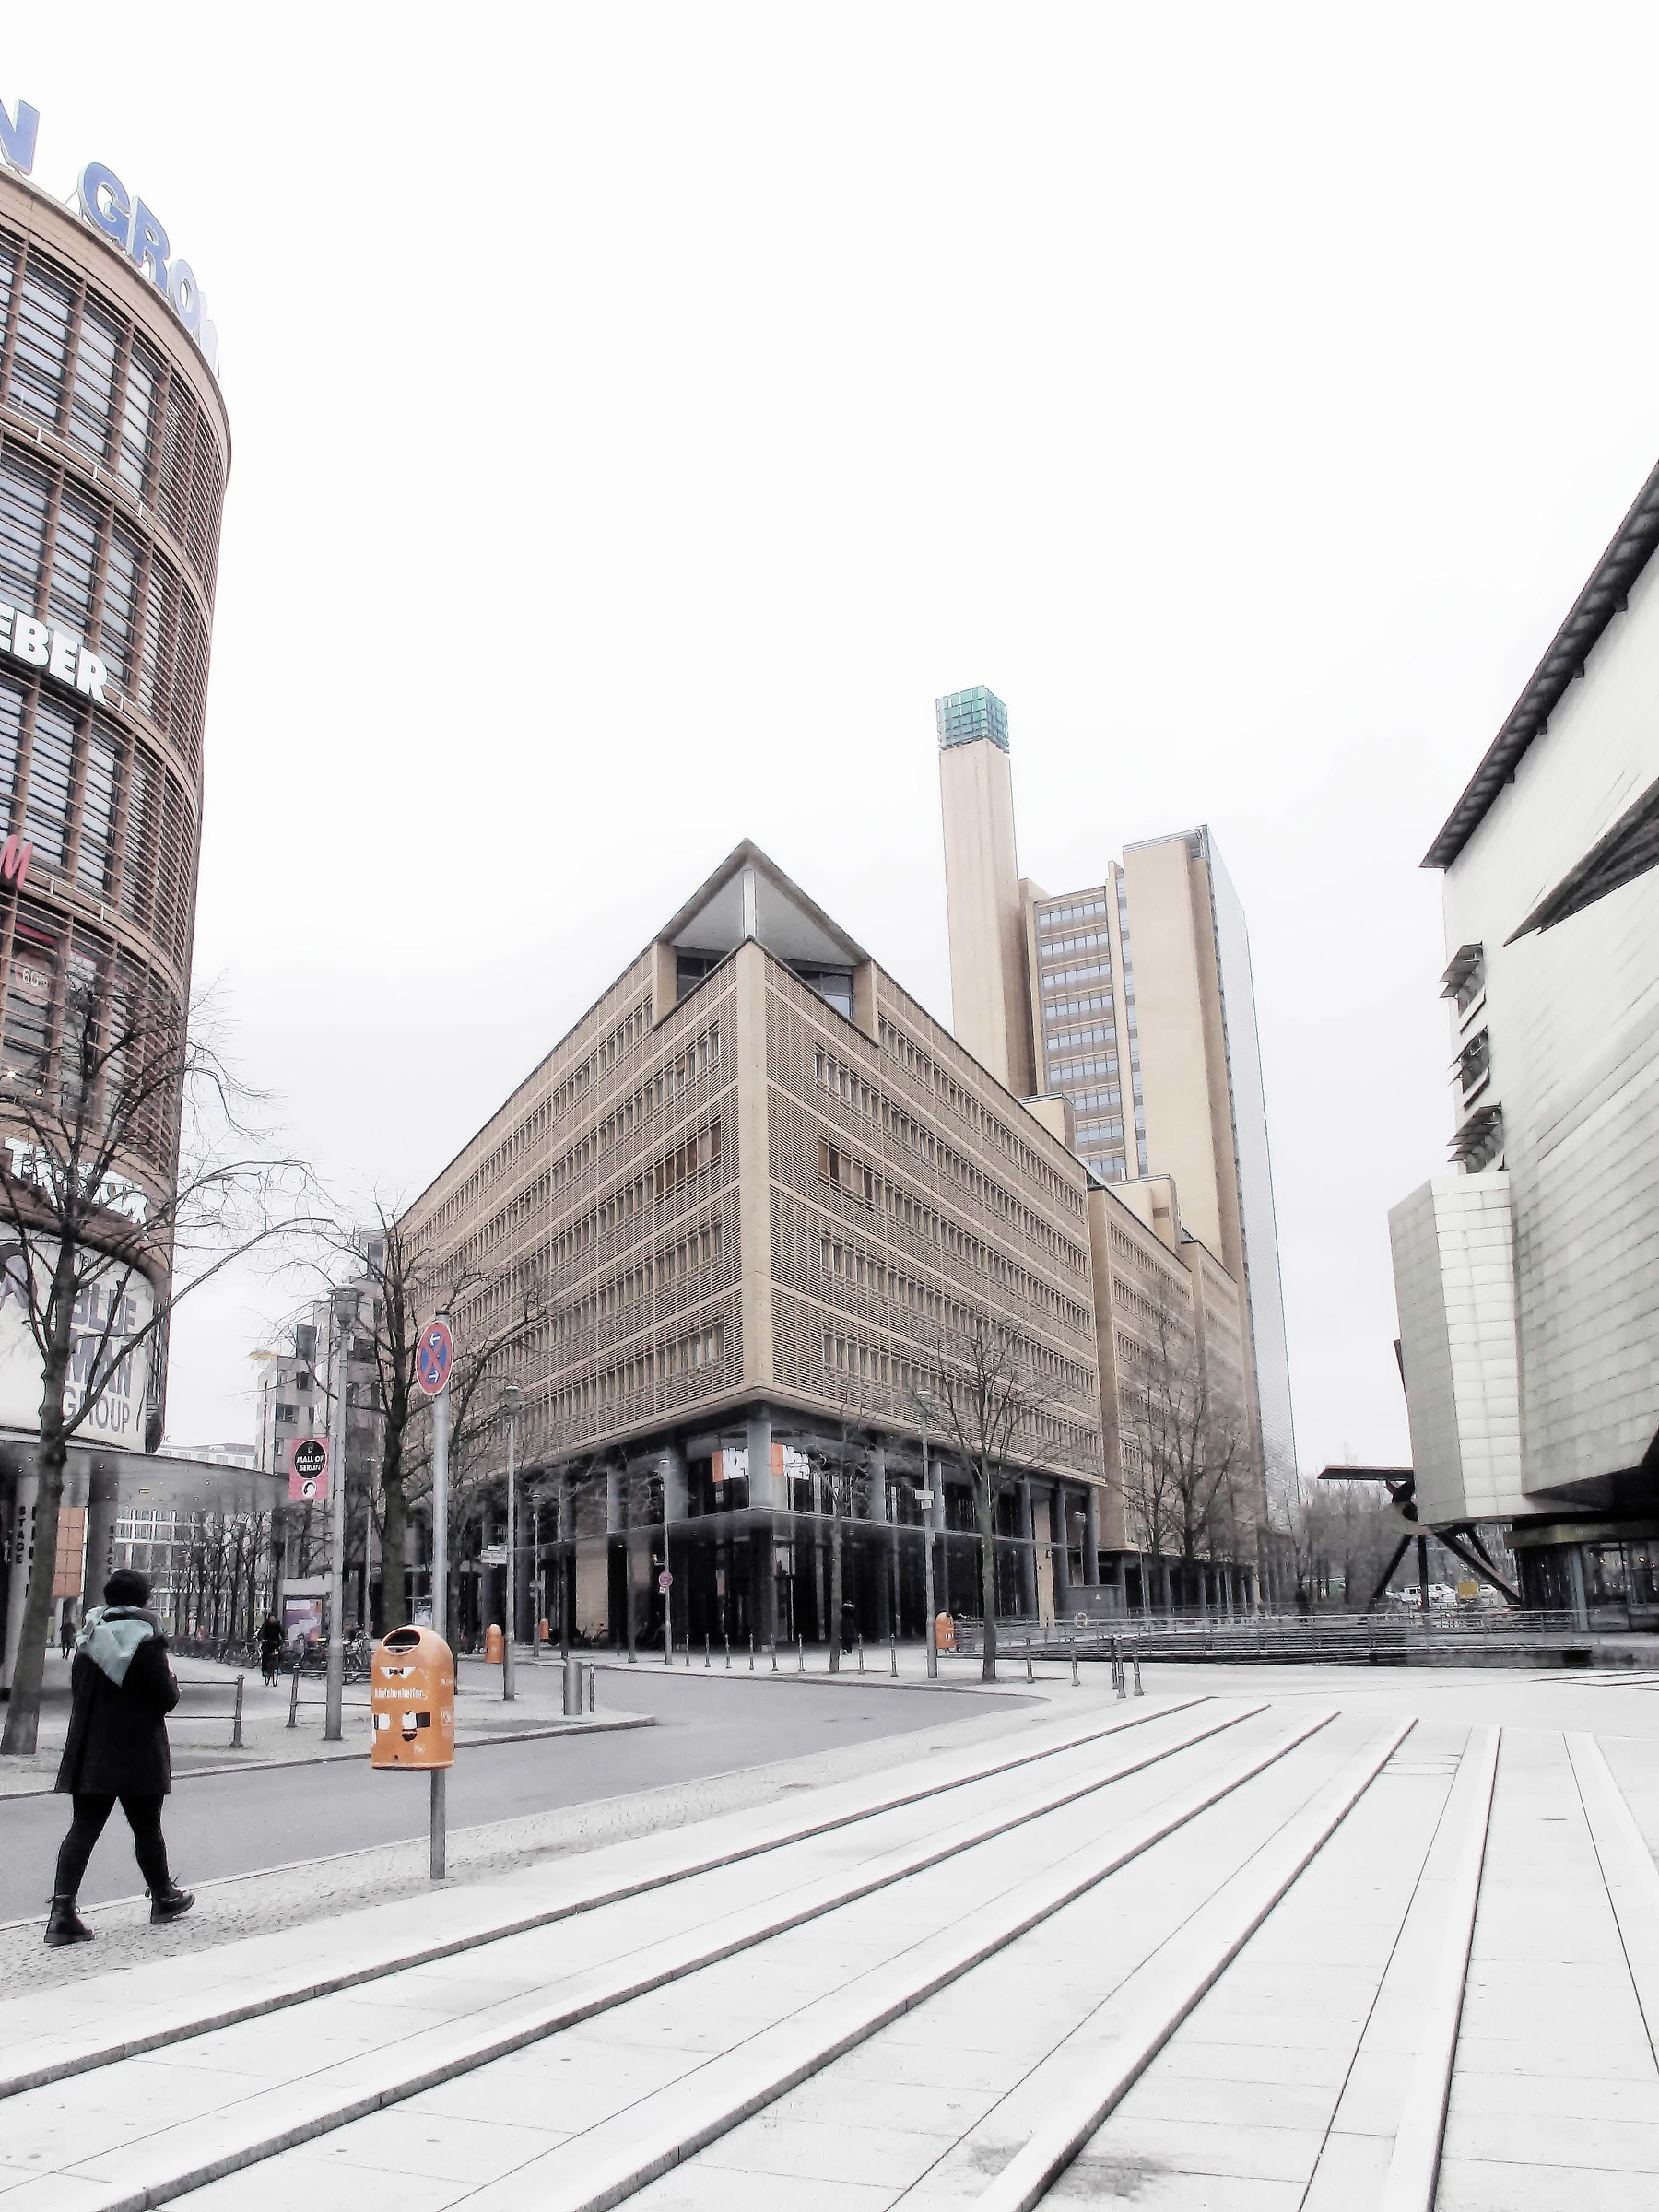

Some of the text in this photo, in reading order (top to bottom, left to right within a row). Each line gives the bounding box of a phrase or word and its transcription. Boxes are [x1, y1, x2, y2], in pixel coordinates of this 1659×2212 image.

[297, 1454, 324, 1464] MALL OF
[299, 1464, 321, 1472] BERLIN
[16, 1506, 27, 1564] STAGE
